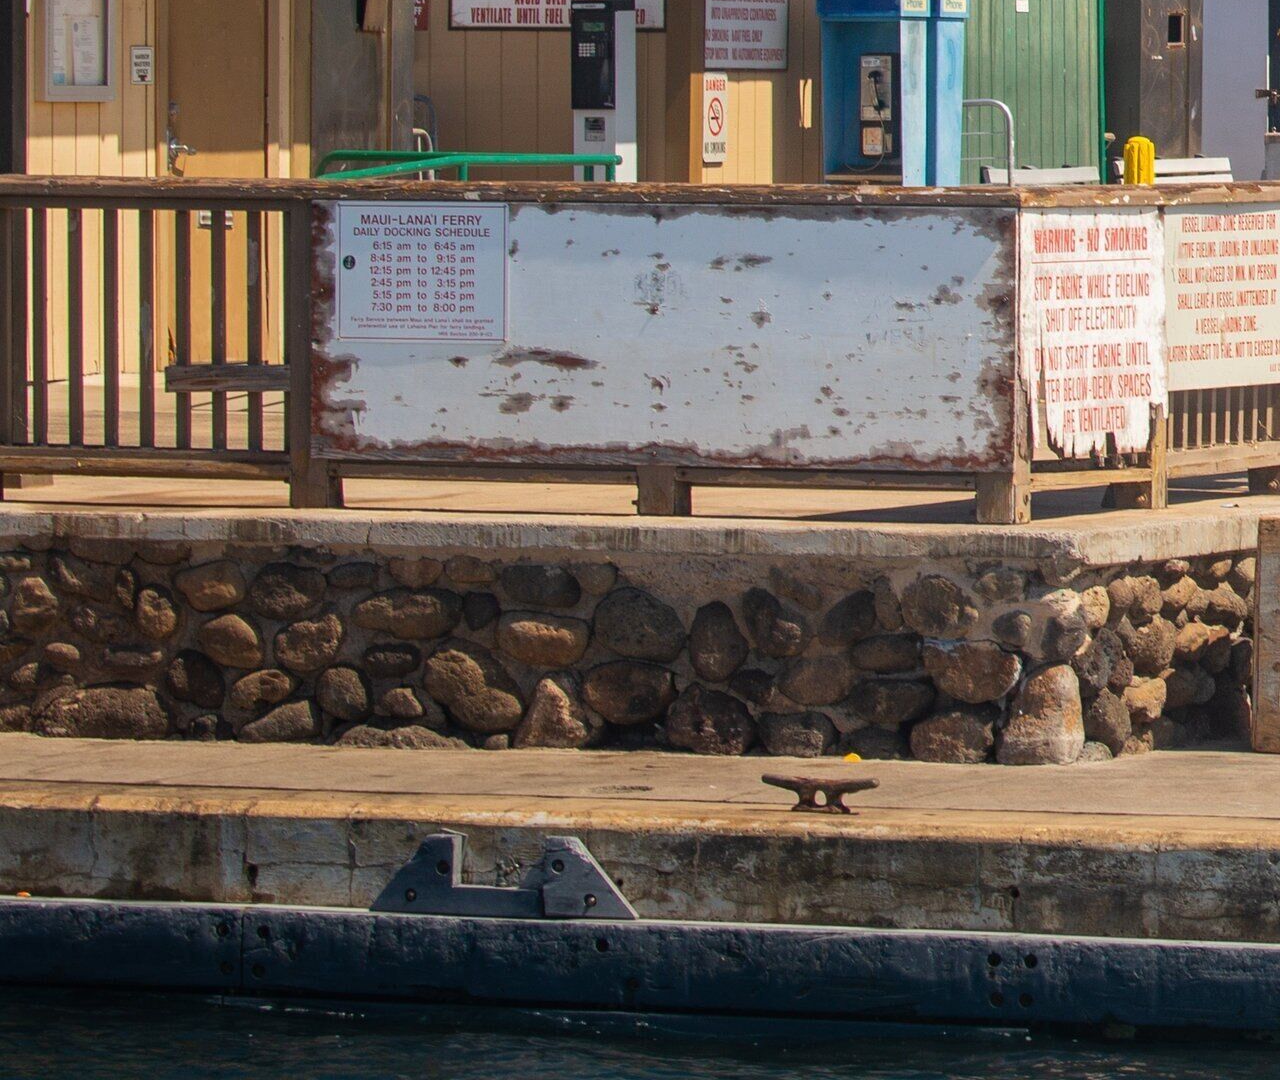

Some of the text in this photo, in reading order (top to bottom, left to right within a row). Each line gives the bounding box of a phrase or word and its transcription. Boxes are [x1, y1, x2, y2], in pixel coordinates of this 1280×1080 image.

[471, 8, 512, 25] VENTILATE
[516, 8, 540, 25] UNTIL
[545, 8, 564, 25] FUEL
[705, 80, 726, 91] DANGER
[710, 142, 726, 154] SMOKING
[442, 215, 482, 226] FERRY
[1182, 214, 1276, 232] VESSEL LOADING ZONE RESERVED FOR
[354, 228, 490, 237] DAILY DOCKING SCHEDULE
[1034, 227, 1148, 254] WARNING NO SMOKING
[372, 242, 392, 251] 6:15
[417, 242, 427, 251] to
[434, 242, 456, 251] 6:45
[1242, 240, 1249, 256] OR
[1250, 240, 1278, 256] UNLOADING
[370, 254, 392, 263] 8:45
[417, 254, 427, 263] to
[436, 254, 456, 263] 9:15
[370, 266, 475, 277] 12:15 pm to 12:45 pm
[1178, 268, 1193, 284] SHALL
[1195, 268, 1204, 283] NOT
[1206, 266, 1225, 282] EXCEED
[1249, 265, 1255, 280] NO
[1258, 264, 1277, 280] PERSON
[370, 278, 475, 289] 2:45 pm to 3:15 pm
[1034, 274, 1149, 301] STOP ENGINE WHILE FUELING
[372, 291, 475, 302] 5:15 pm to 5:45 pm
[1178, 294, 1193, 310] SHALL
[1195, 292, 1210, 309] LEAVE
[1216, 292, 1235, 307] VESSEL
[1236, 290, 1268, 307] UNATTENDED
[1270, 290, 1277, 305] AT
[372, 303, 475, 314] 7:30 pm to 8:00 pm
[1046, 306, 1137, 332] SHUT OFF ELECTRICITY
[1048, 346, 1062, 371] NOT
[1066, 346, 1089, 369] START
[1093, 344, 1122, 368] ENGINE
[1126, 342, 1152, 366] UNTIL
[1190, 344, 1211, 360] SUBJECT
[1214, 344, 1219, 359] TO
[1236, 342, 1245, 357] NOT
[1246, 341, 1253, 356] TO
[1254, 340, 1273, 356] EXCEED
[1064, 374, 1152, 401] BELOW-DECK SPACES
[1064, 406, 1126, 433] ARE VENTILATED
